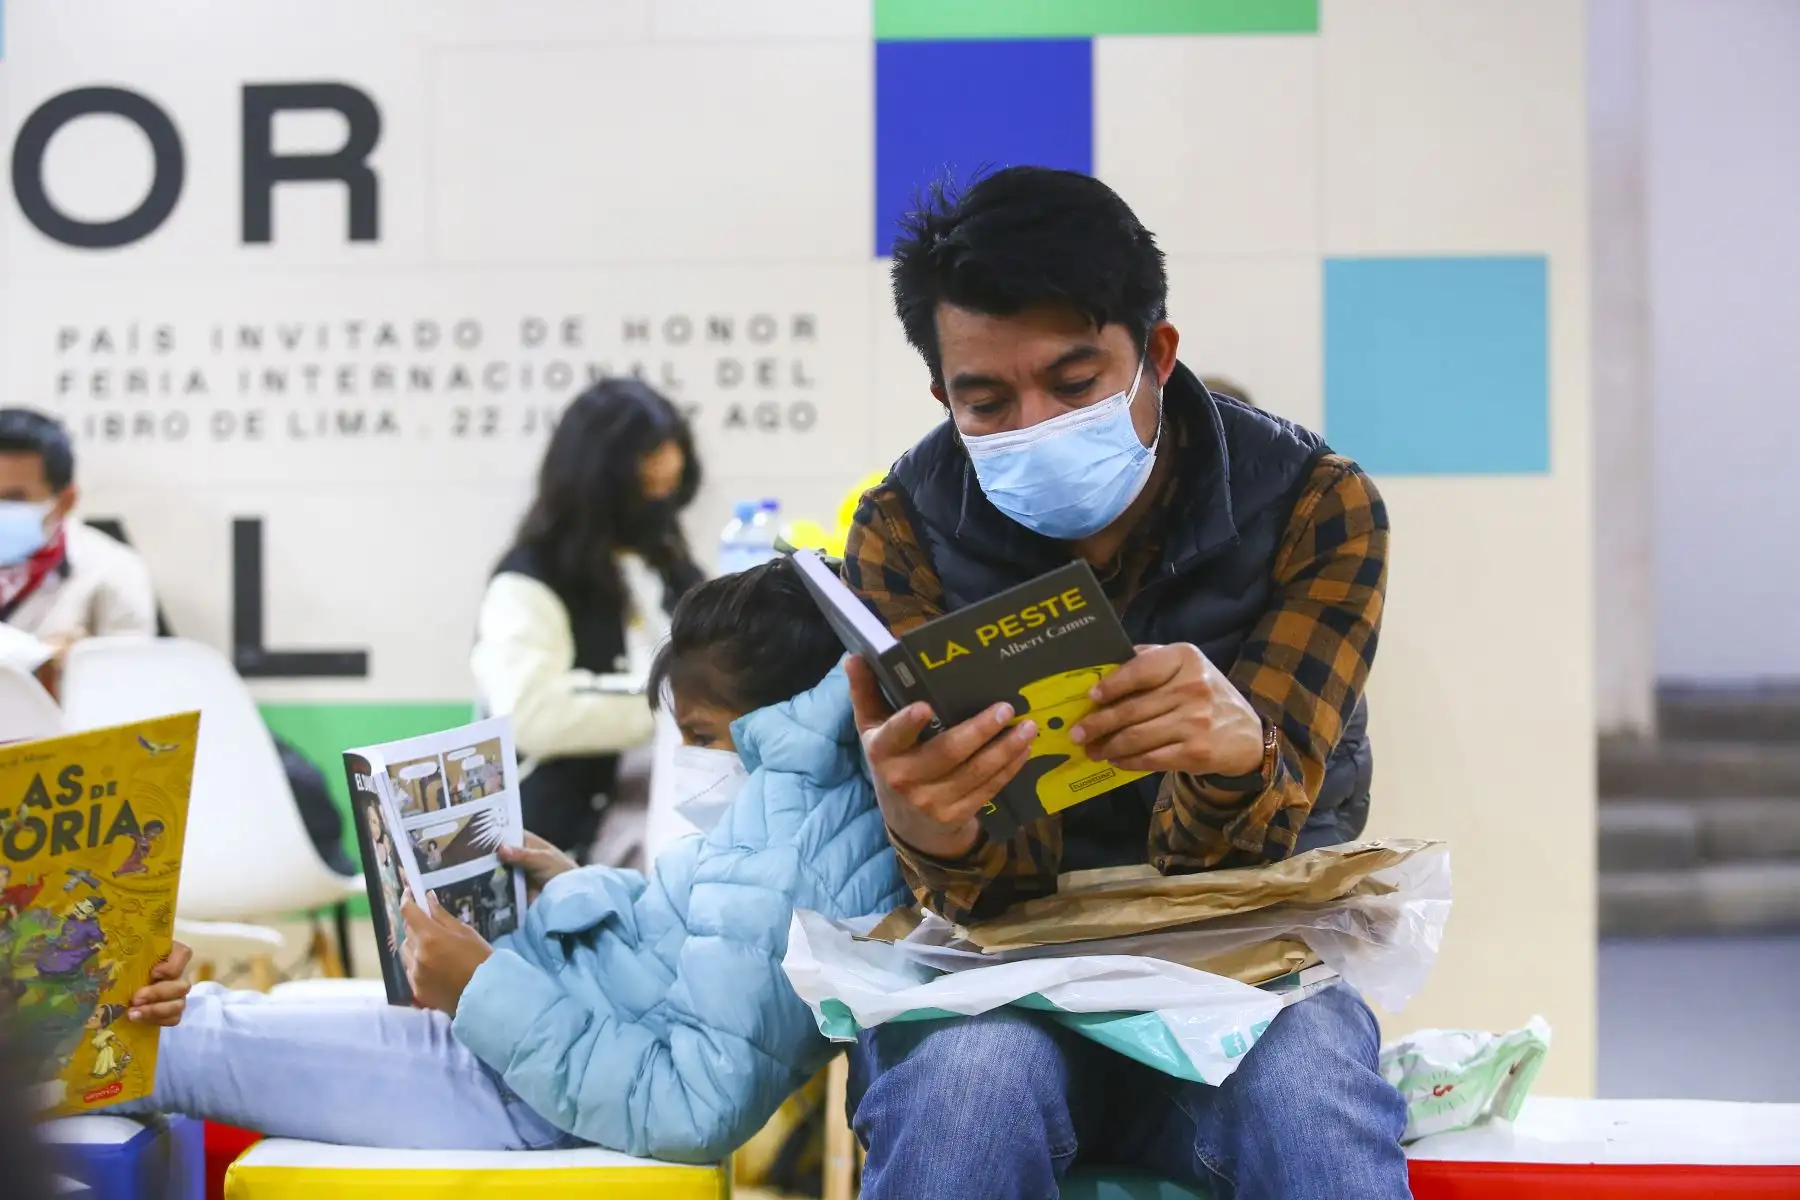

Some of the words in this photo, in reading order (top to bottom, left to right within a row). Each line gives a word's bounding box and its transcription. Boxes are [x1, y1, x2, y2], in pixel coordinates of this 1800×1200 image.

[10, 81, 383, 251] OR
[211, 317, 483, 352] INVITADO
[519, 315, 583, 349] DE
[621, 313, 818, 347] HONOR
[55, 366, 209, 400] FERIA
[715, 356, 815, 390] DEL
[72, 410, 190, 443] IBRO
[210, 409, 264, 442] DE
[286, 407, 401, 441] LIMA
[451, 405, 501, 438] 22
[721, 399, 818, 434] AGO
[919, 639, 972, 670] LA
[975, 587, 1088, 648] PESTE
[1000, 632, 1044, 659] Albert
[1045, 614, 1097, 639] Camus
[22, 764, 85, 810] AS
[90, 780, 118, 800] DE
